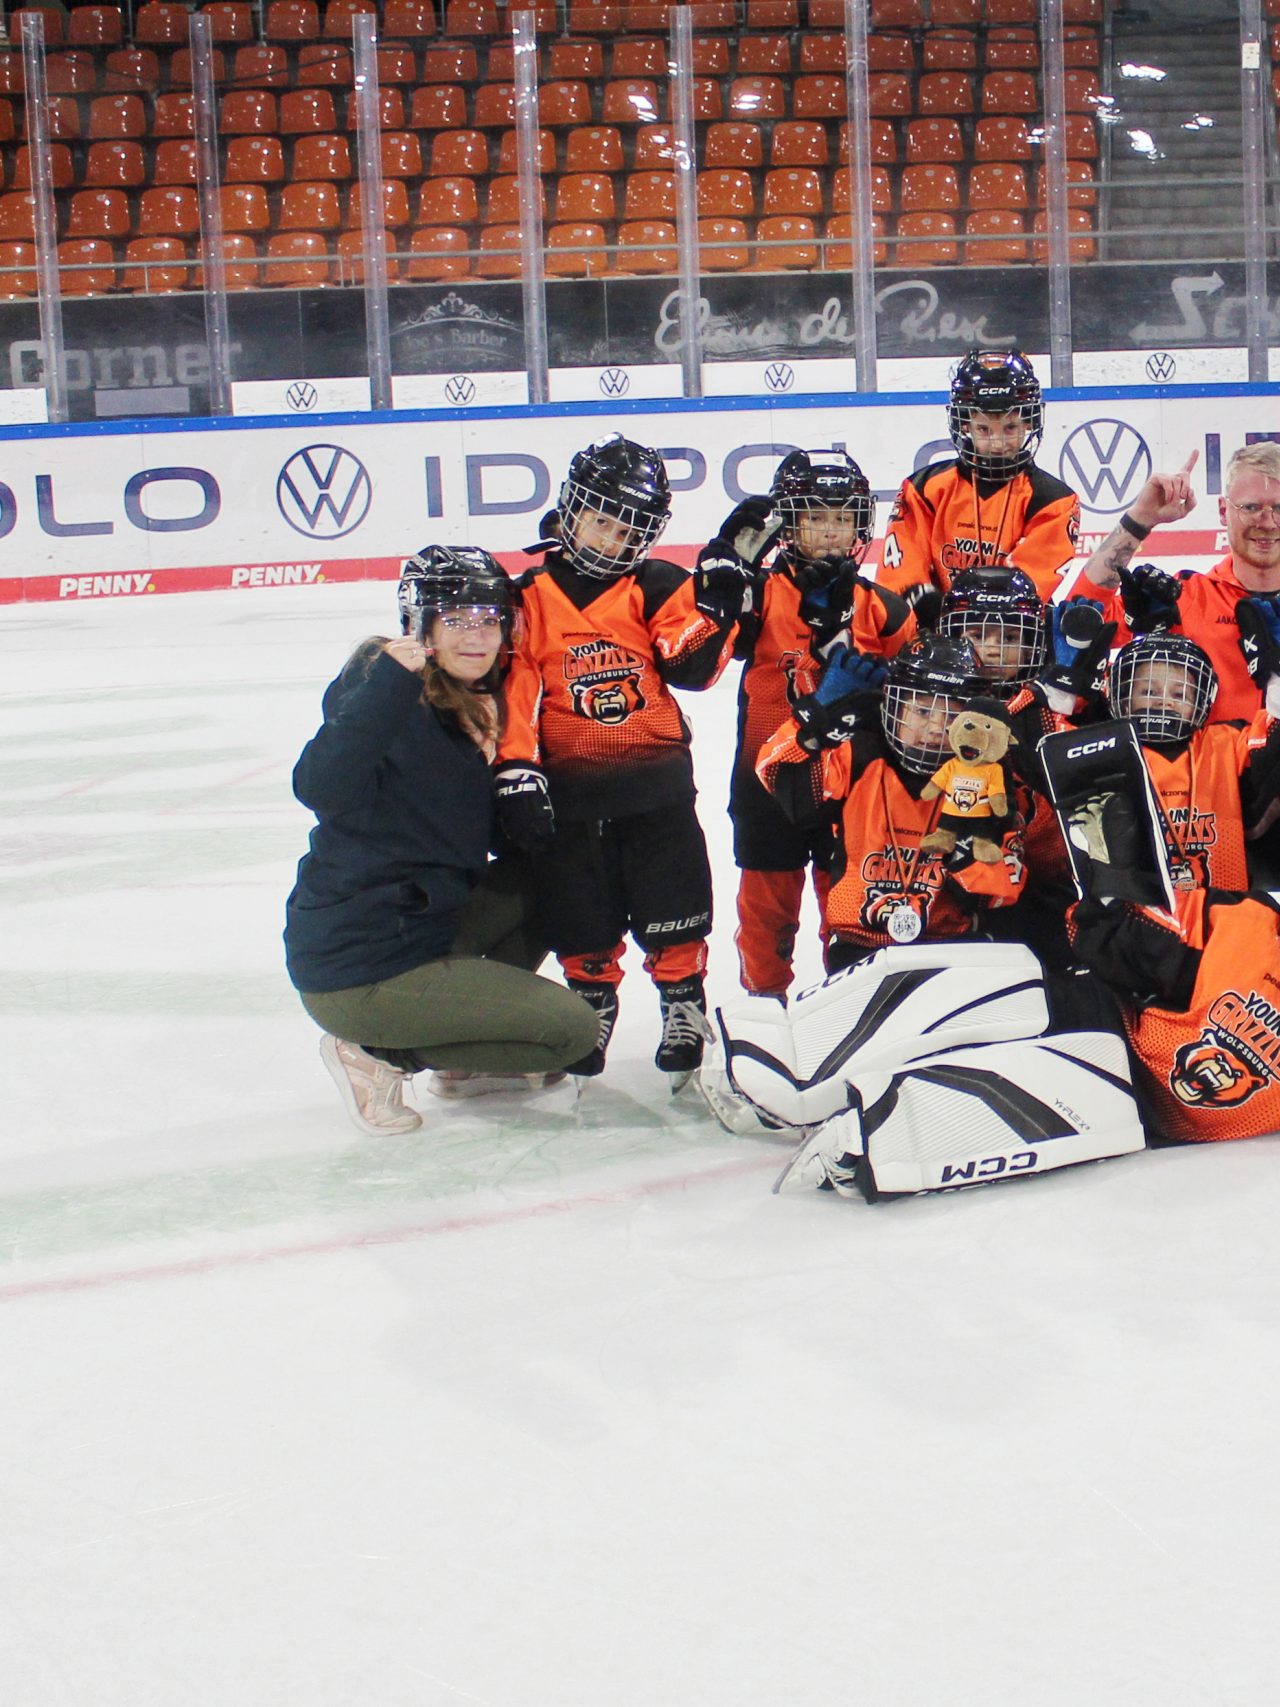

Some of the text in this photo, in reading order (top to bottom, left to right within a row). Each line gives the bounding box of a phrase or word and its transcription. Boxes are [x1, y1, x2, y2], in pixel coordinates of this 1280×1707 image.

[979, 387, 1011, 395] CCM
[276, 443, 372, 540] VW
[816, 475, 850, 486] CCM
[0, 466, 221, 539] LO
[883, 532, 903, 569] 4
[976, 593, 1011, 602] CCM
[579, 671, 631, 683] WOLFSBURG
[927, 672, 965, 686] BAUER
[1067, 737, 1116, 759] CCM
[498, 782, 538, 796] RUE
[877, 881, 926, 891] WOLFRG
[645, 912, 710, 934] BAUER
[796, 953, 875, 1002] CCM
[1217, 1029, 1269, 1077] WOLFSBURG
[941, 1151, 1038, 1184] CCM
